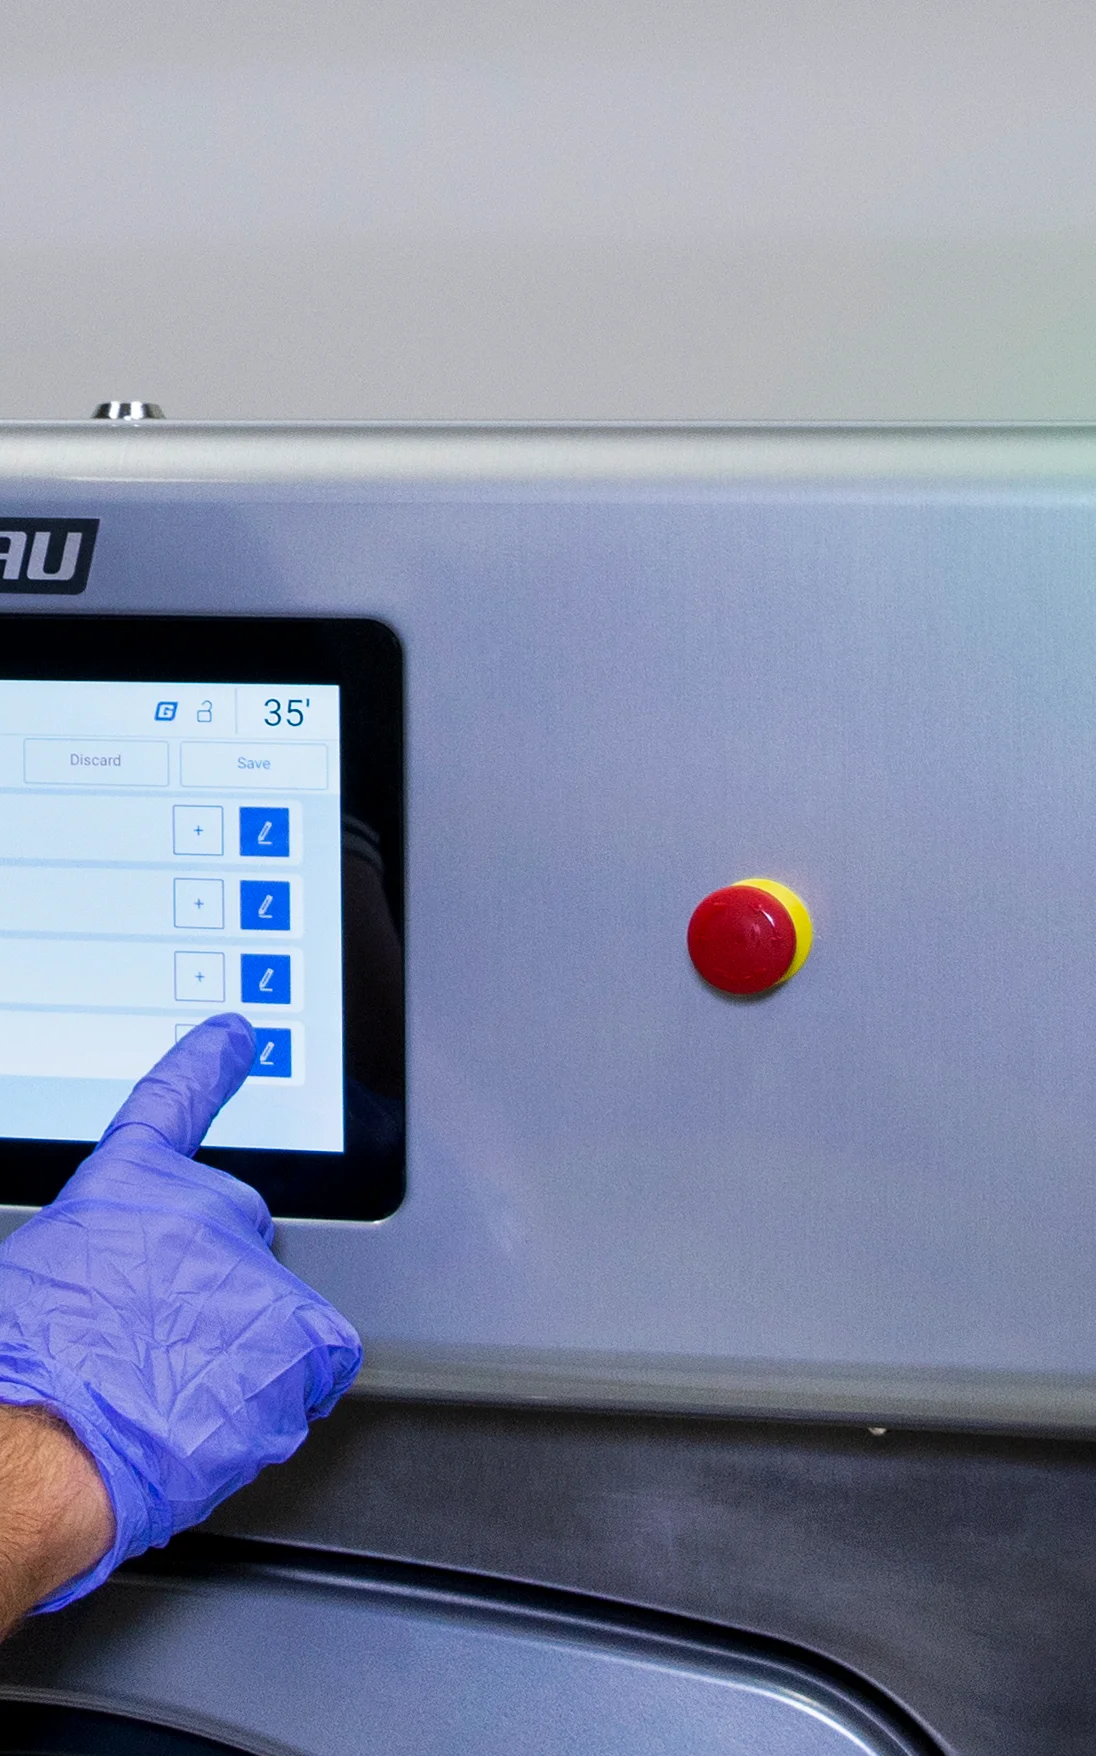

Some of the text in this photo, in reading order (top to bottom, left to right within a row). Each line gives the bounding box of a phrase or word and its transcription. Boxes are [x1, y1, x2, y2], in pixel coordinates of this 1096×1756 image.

[264, 698, 311, 727] 35'
[70, 753, 121, 767] Discard
[237, 757, 271, 770] Save
